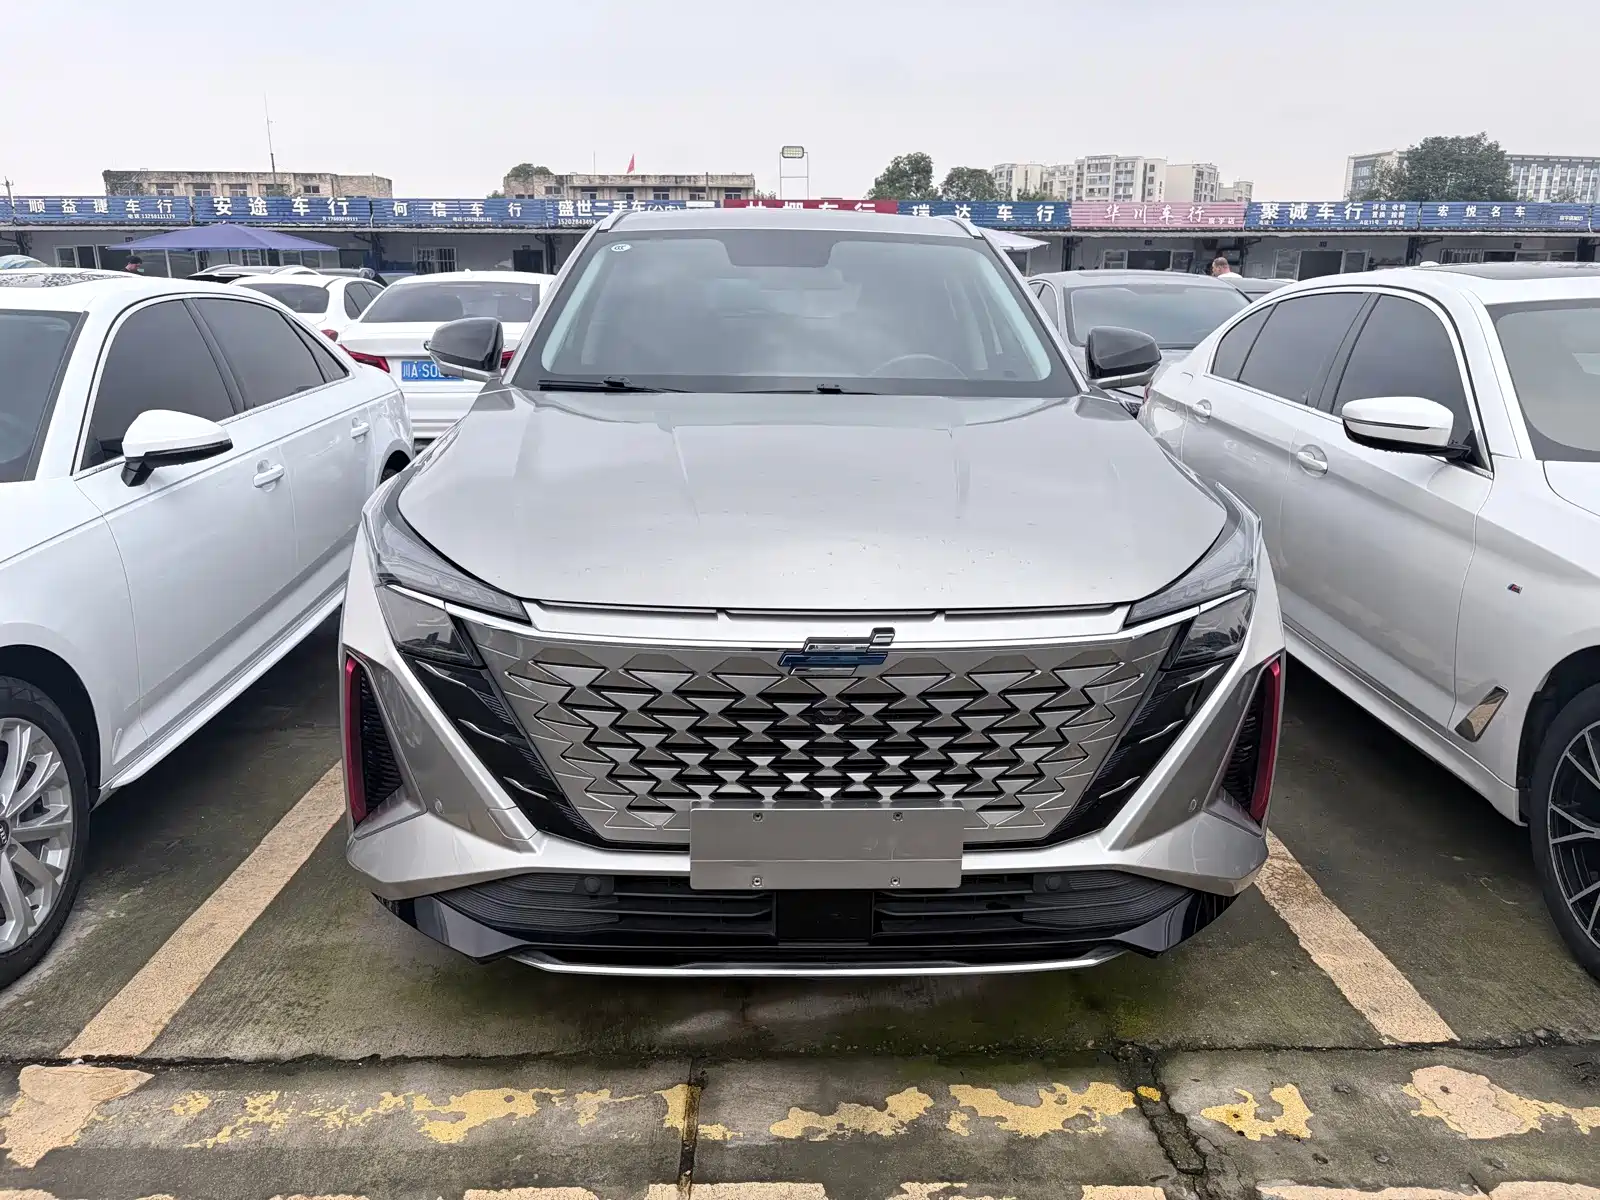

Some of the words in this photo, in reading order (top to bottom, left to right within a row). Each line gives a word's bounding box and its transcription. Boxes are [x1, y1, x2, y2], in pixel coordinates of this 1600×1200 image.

[28, 198, 173, 214] 顺益捷车行
[213, 196, 350, 216] 安途车行
[392, 201, 522, 218] 何信车行
[911, 203, 1055, 222] 瑞达车行
[1104, 204, 1205, 225] 华川车行
[1259, 202, 1364, 220] 聚诚车行
[1437, 205, 1526, 218] 宏悦名车
